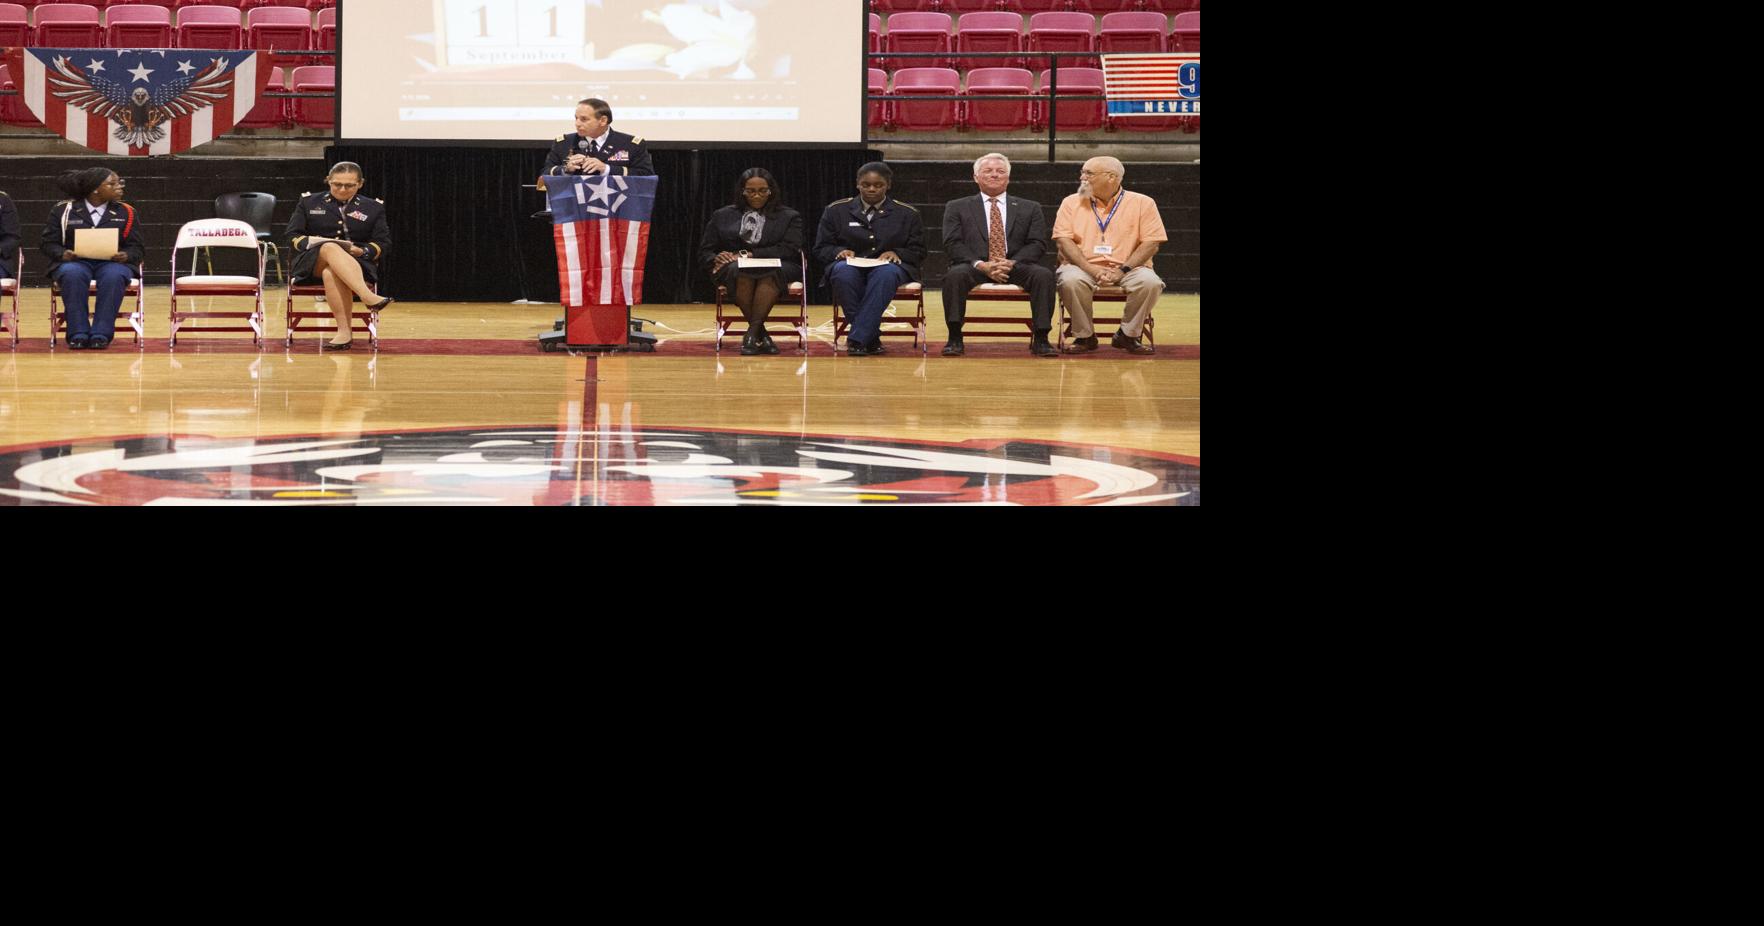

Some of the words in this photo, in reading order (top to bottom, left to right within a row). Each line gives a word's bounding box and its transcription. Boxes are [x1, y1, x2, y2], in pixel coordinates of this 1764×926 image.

[472, 4, 494, 38] 1
[543, 5, 563, 38] 1
[466, 50, 567, 62] September
[1144, 101, 1200, 113] NEVER
[187, 228, 249, 237] TALLADEGA
